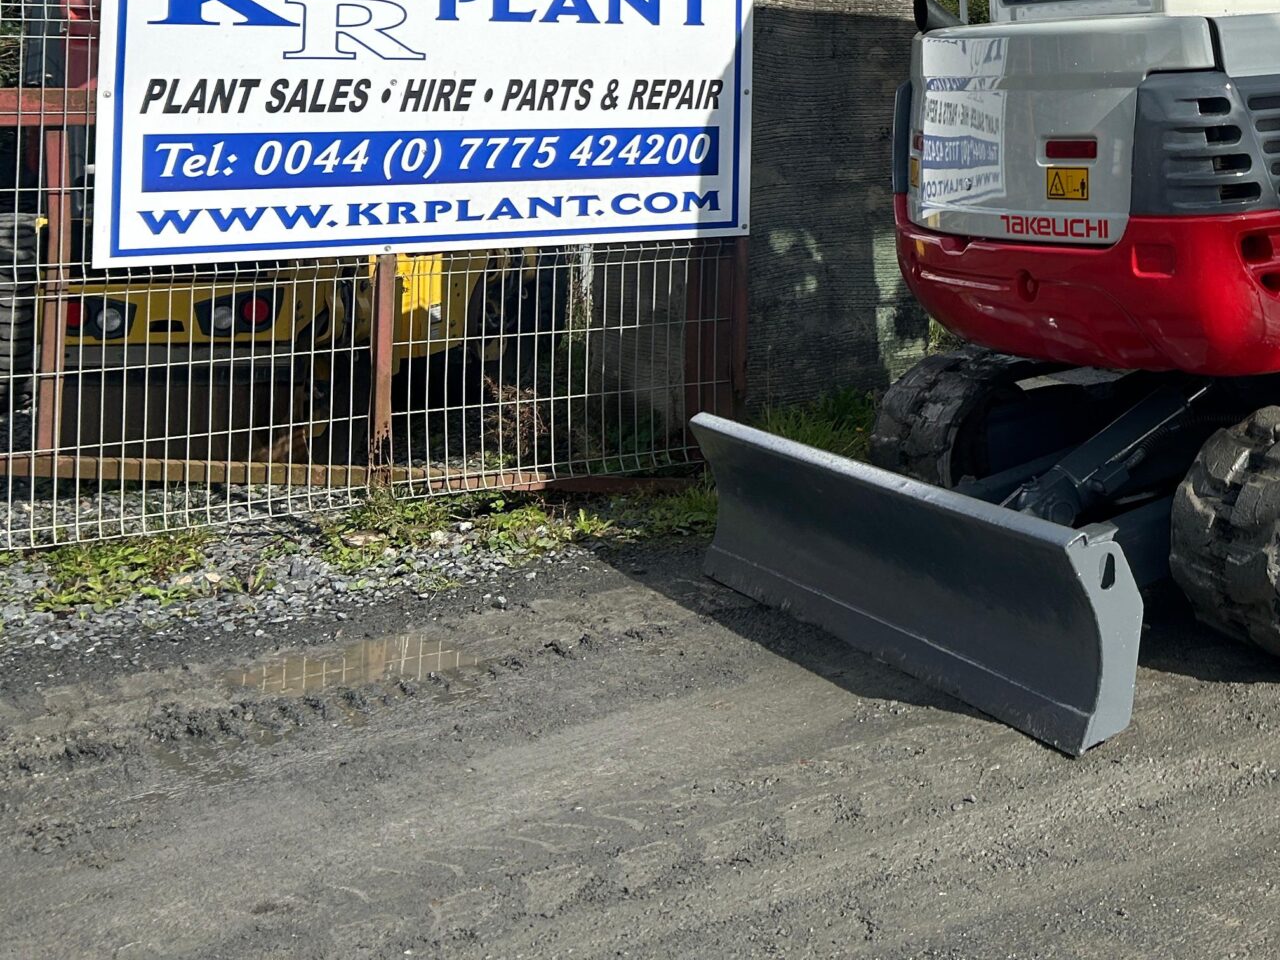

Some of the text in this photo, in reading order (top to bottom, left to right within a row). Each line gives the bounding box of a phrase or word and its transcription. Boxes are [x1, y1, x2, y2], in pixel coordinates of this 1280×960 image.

[140, 78, 724, 114] PLANT SALES HIRE PARTS & REPAIR
[155, 133, 710, 179] Tel: 0044 (0) 7775 424200
[137, 190, 721, 234] WWW.KRPLANT.COM
[1000, 215, 1109, 238] TAKEUCHI
